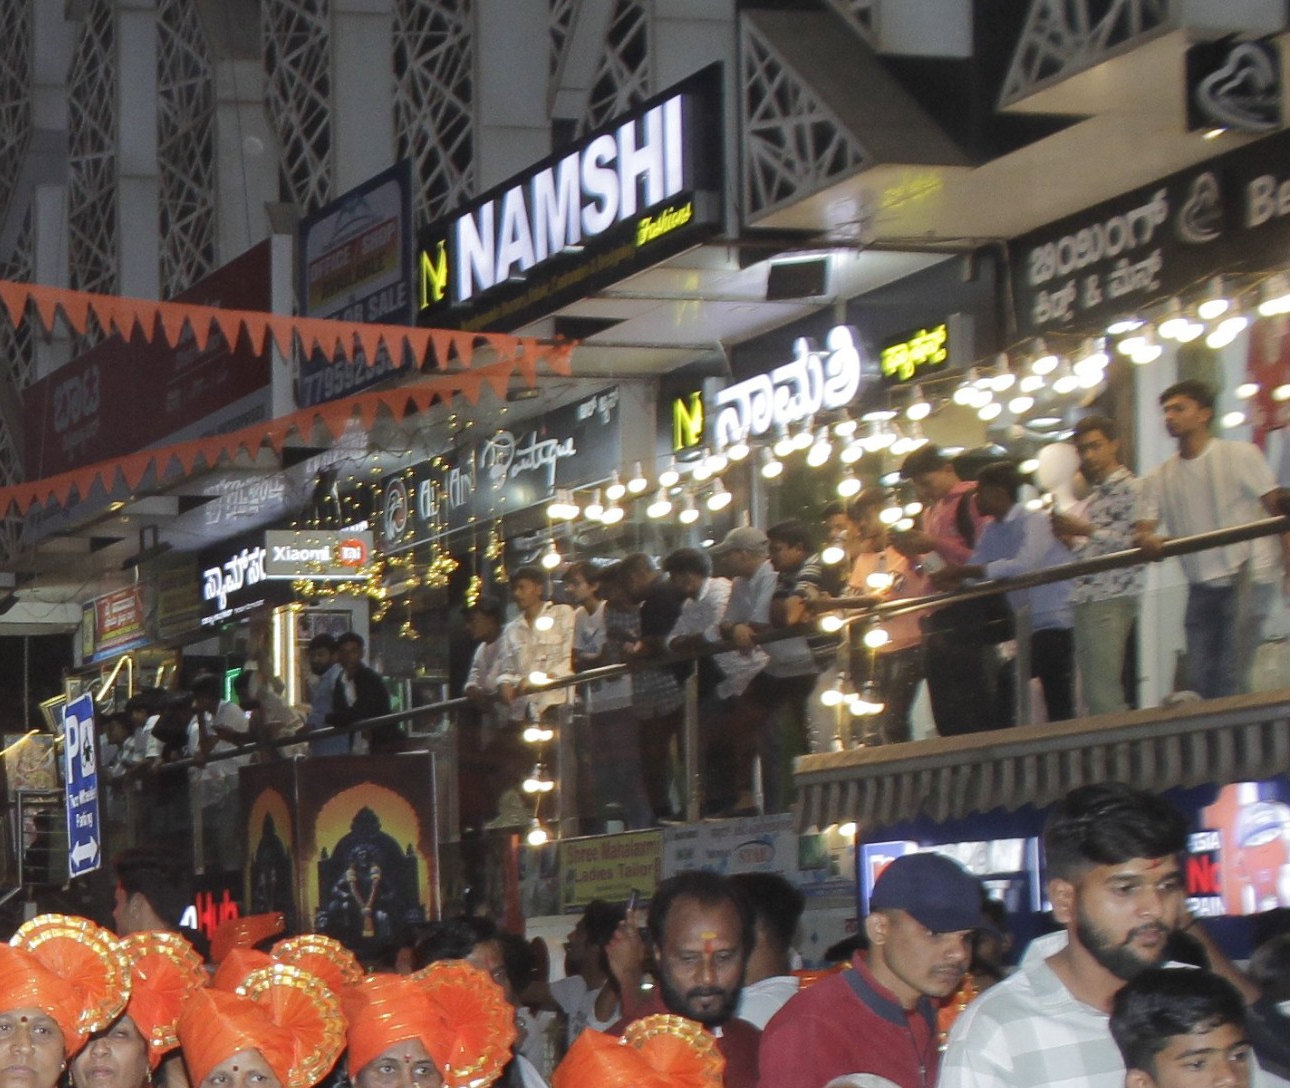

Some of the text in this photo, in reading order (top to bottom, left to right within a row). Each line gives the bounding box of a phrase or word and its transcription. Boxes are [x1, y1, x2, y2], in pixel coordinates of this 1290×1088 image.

[456, 94, 684, 303] NAMSHI
[367, 282, 408, 321] SALE
[273, 545, 330, 562] Xiaomi
[65, 714, 79, 785] P
